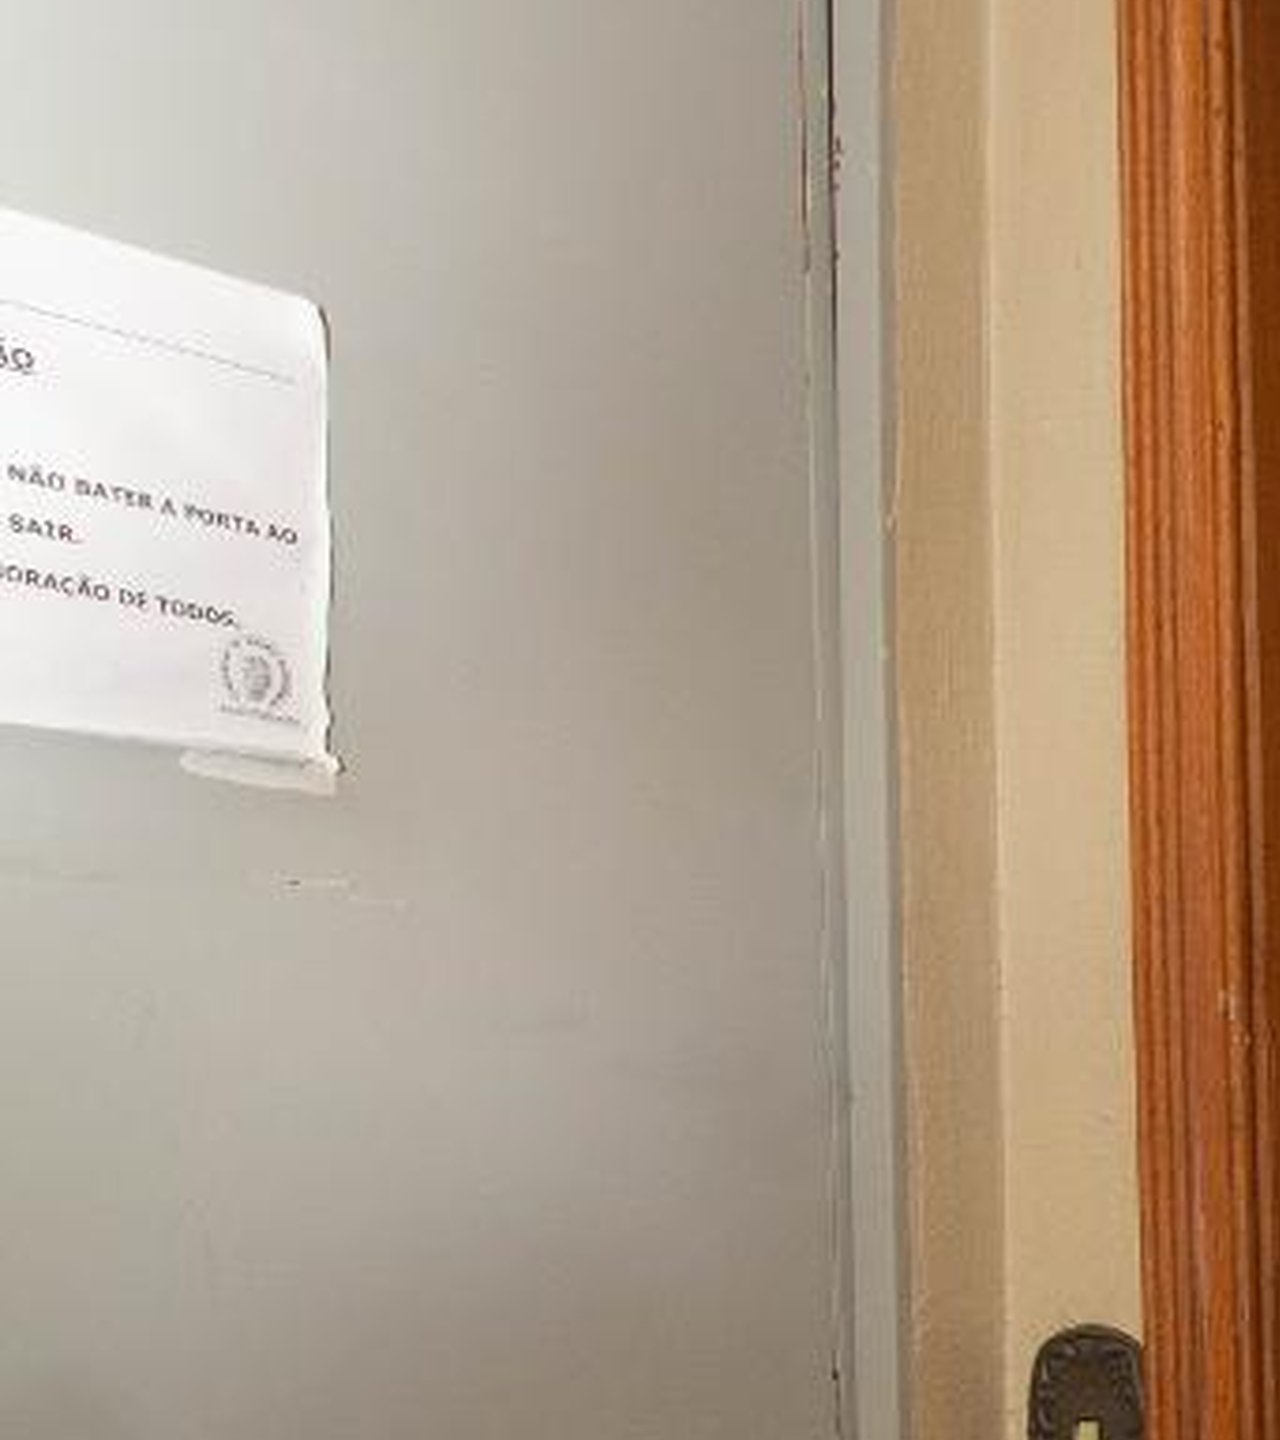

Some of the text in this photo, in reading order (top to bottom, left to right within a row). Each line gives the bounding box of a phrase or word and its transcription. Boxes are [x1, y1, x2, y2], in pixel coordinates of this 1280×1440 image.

[7, 464, 65, 492] NÃO
[75, 479, 153, 510] BATER
[183, 504, 261, 537] PORTA
[267, 523, 298, 545] AO
[0, 563, 110, 601] ORAÇÃO
[119, 587, 148, 608] DE
